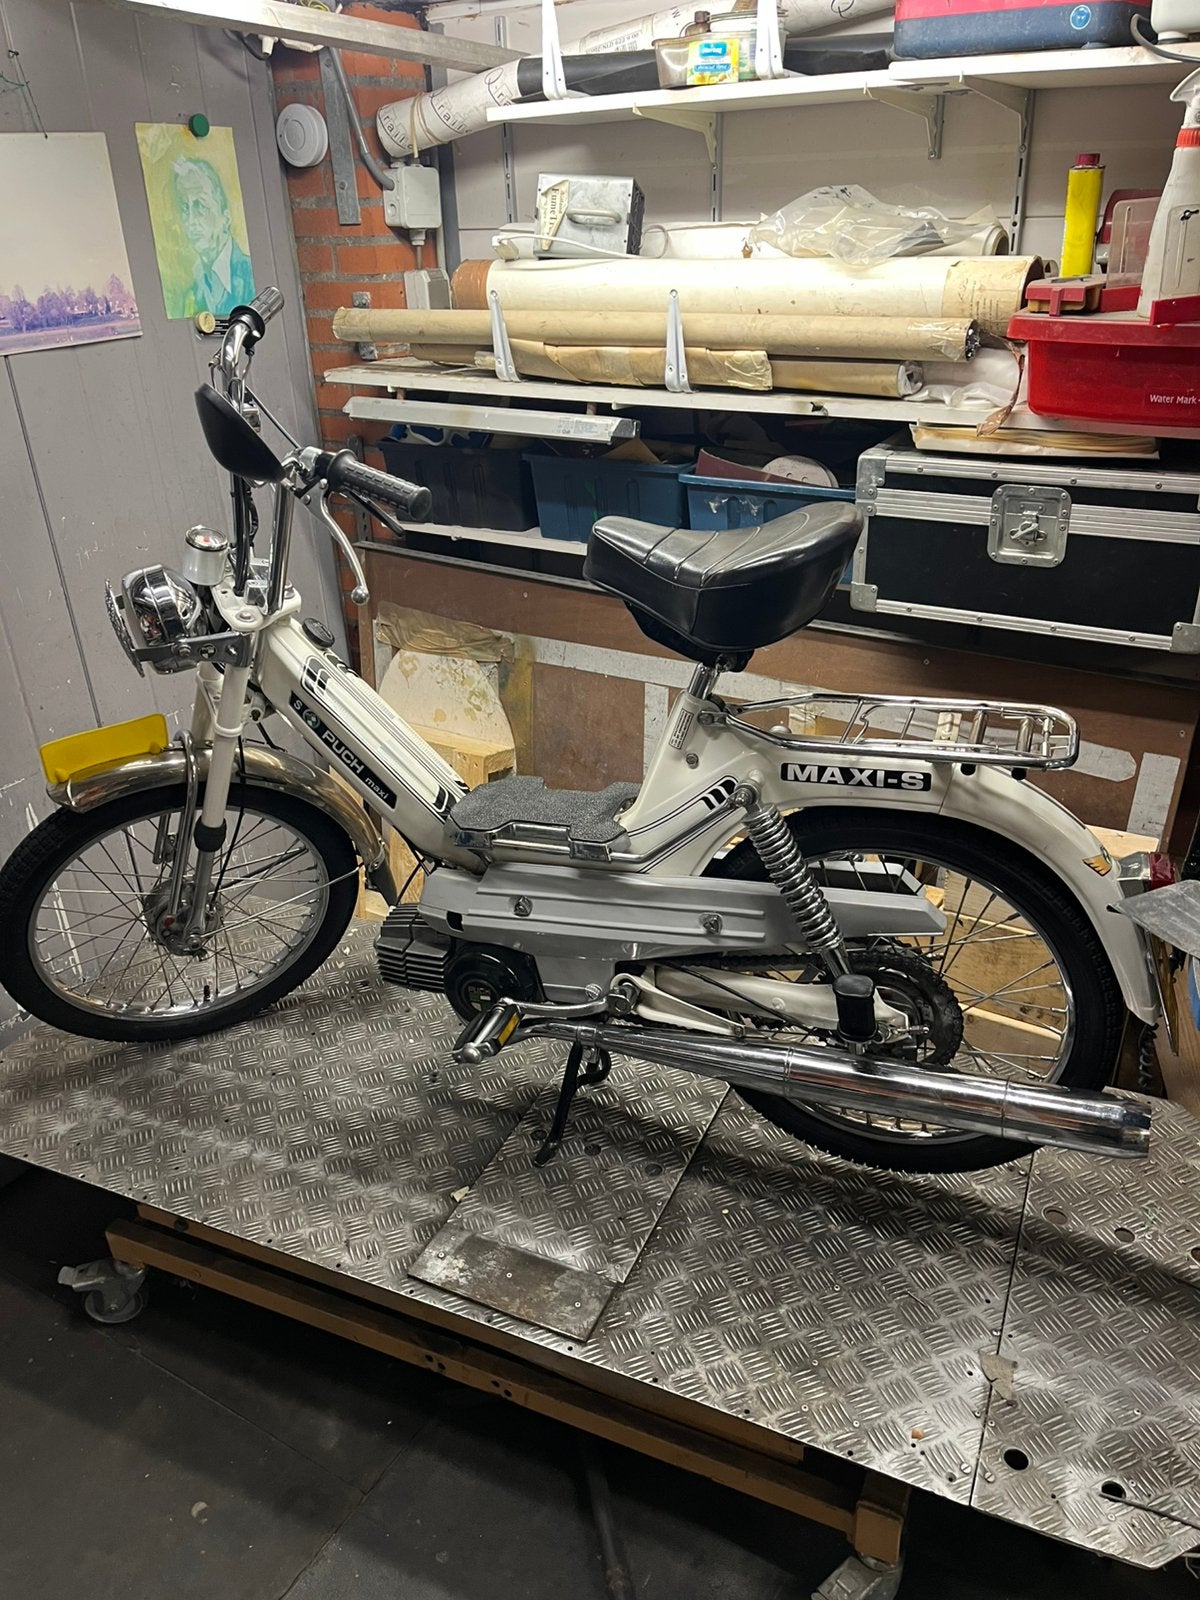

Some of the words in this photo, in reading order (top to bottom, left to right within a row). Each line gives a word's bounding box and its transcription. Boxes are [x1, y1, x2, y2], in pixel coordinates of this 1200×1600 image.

[1150, 394, 1174, 404] Water
[1176, 395, 1197, 405] Mark
[294, 699, 302, 710] S
[321, 730, 365, 774] PUCH
[364, 777, 389, 800] maxi
[786, 763, 924, 790] MAXI-S
